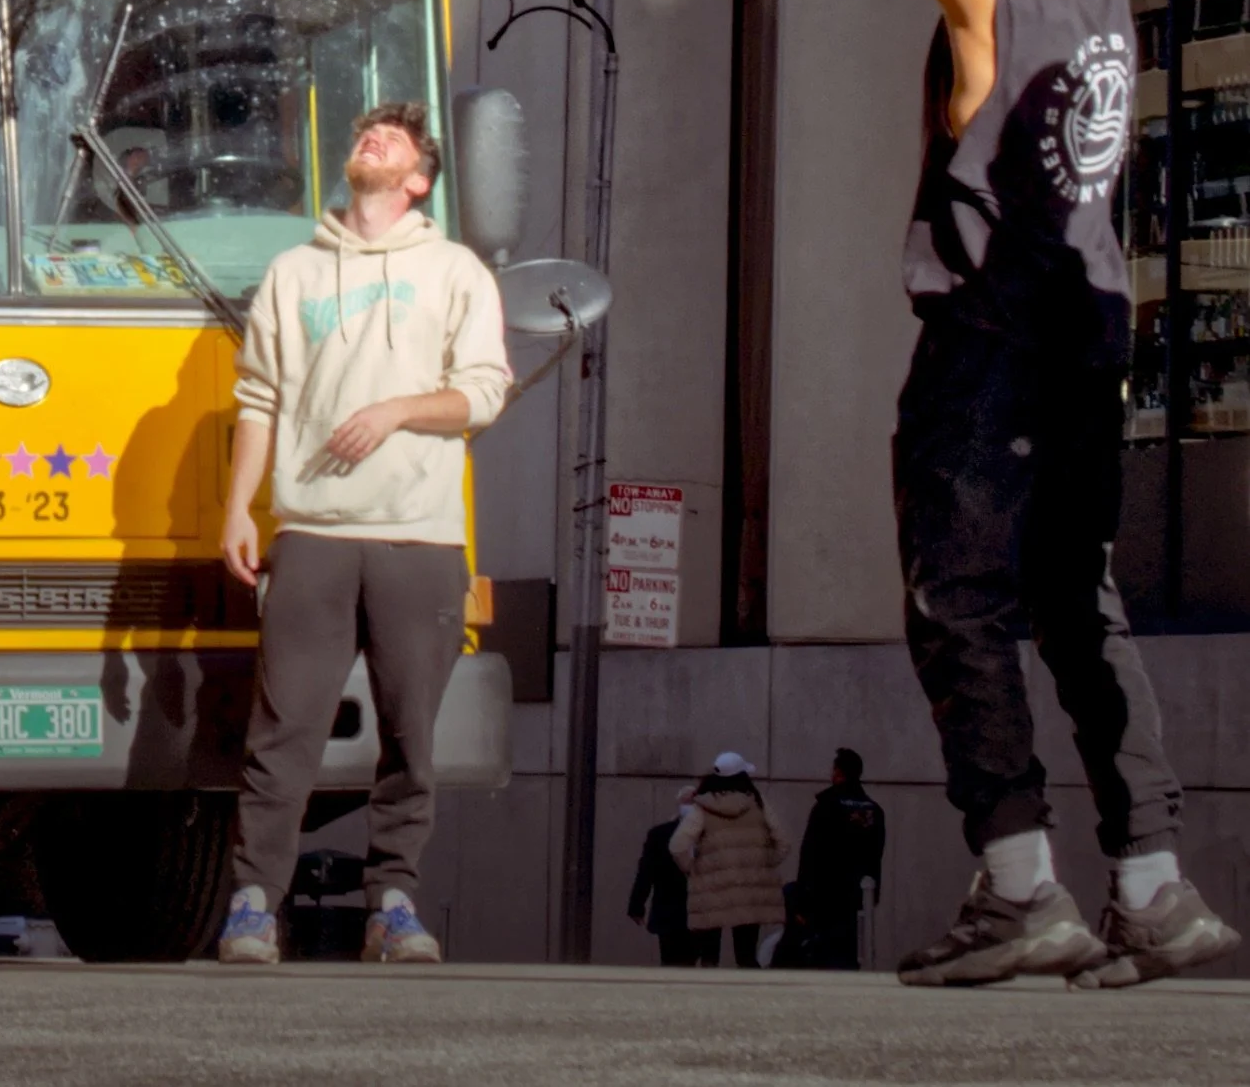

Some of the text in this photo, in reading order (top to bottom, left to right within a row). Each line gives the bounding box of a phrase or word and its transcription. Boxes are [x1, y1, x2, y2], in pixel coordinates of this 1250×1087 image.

[617, 485, 676, 500] TOW-AWAY
[610, 497, 630, 514] NO
[609, 571, 676, 594] NO PARKING
[9, 687, 62, 700] Vermont
[45, 704, 92, 740] 380
